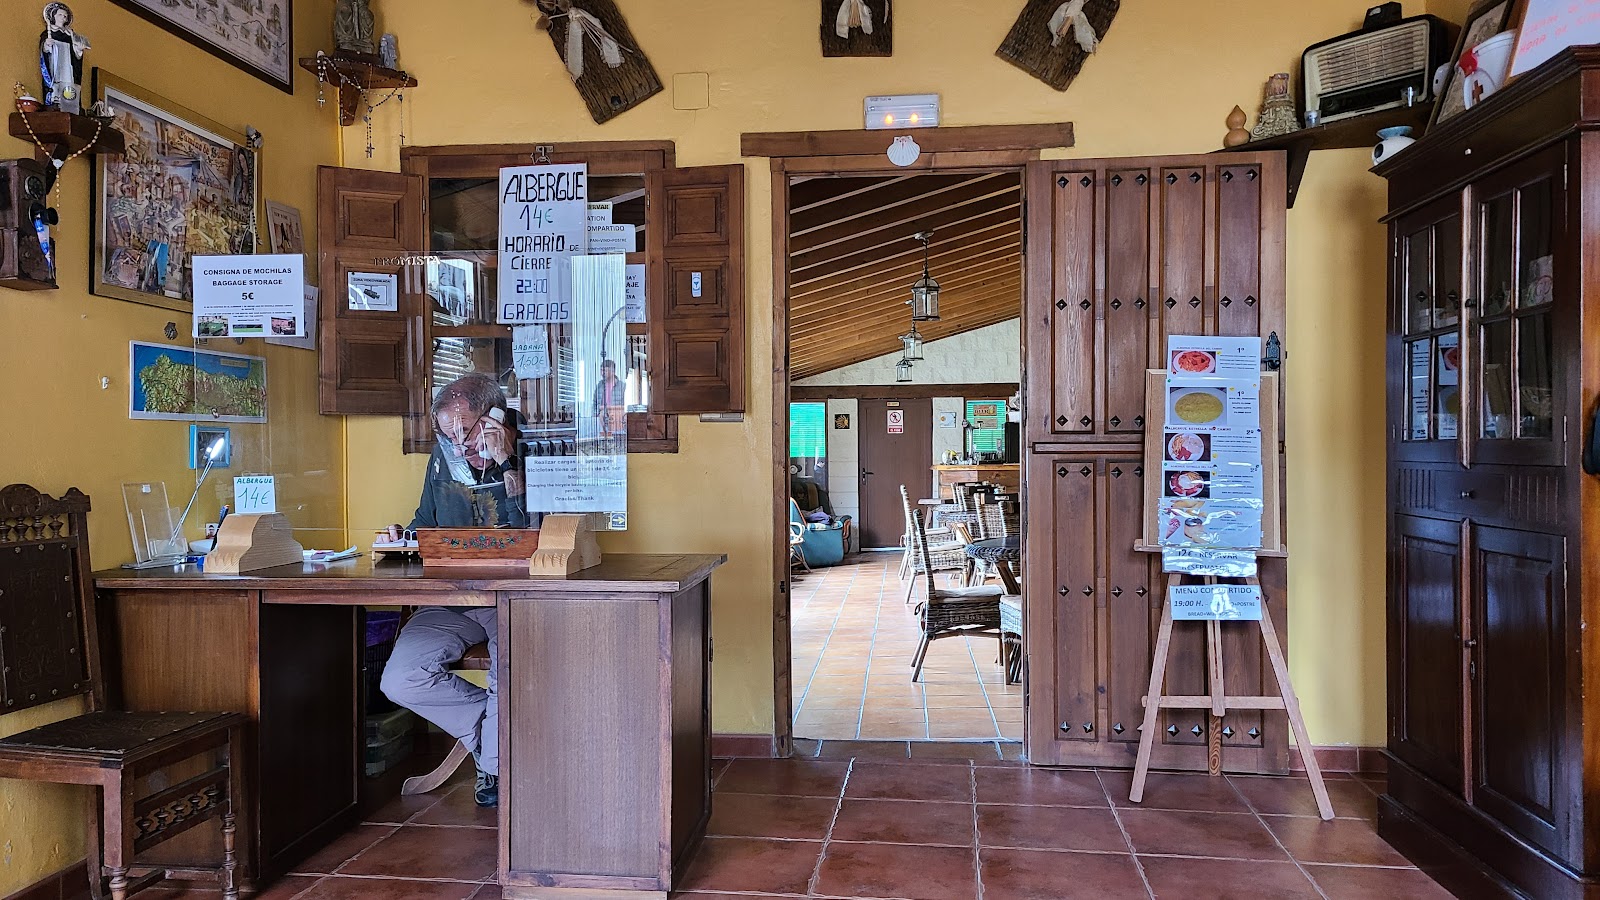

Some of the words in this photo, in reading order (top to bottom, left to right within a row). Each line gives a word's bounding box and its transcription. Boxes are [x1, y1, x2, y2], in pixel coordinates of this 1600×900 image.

[503, 171, 584, 204] ALBERGUE
[519, 204, 554, 231] 14€
[569, 244, 579, 252] DE
[516, 278, 548, 294] 22:00
[241, 292, 254, 300] 5€
[503, 302, 569, 320] GRACIAS
[238, 486, 270, 508] 14€
